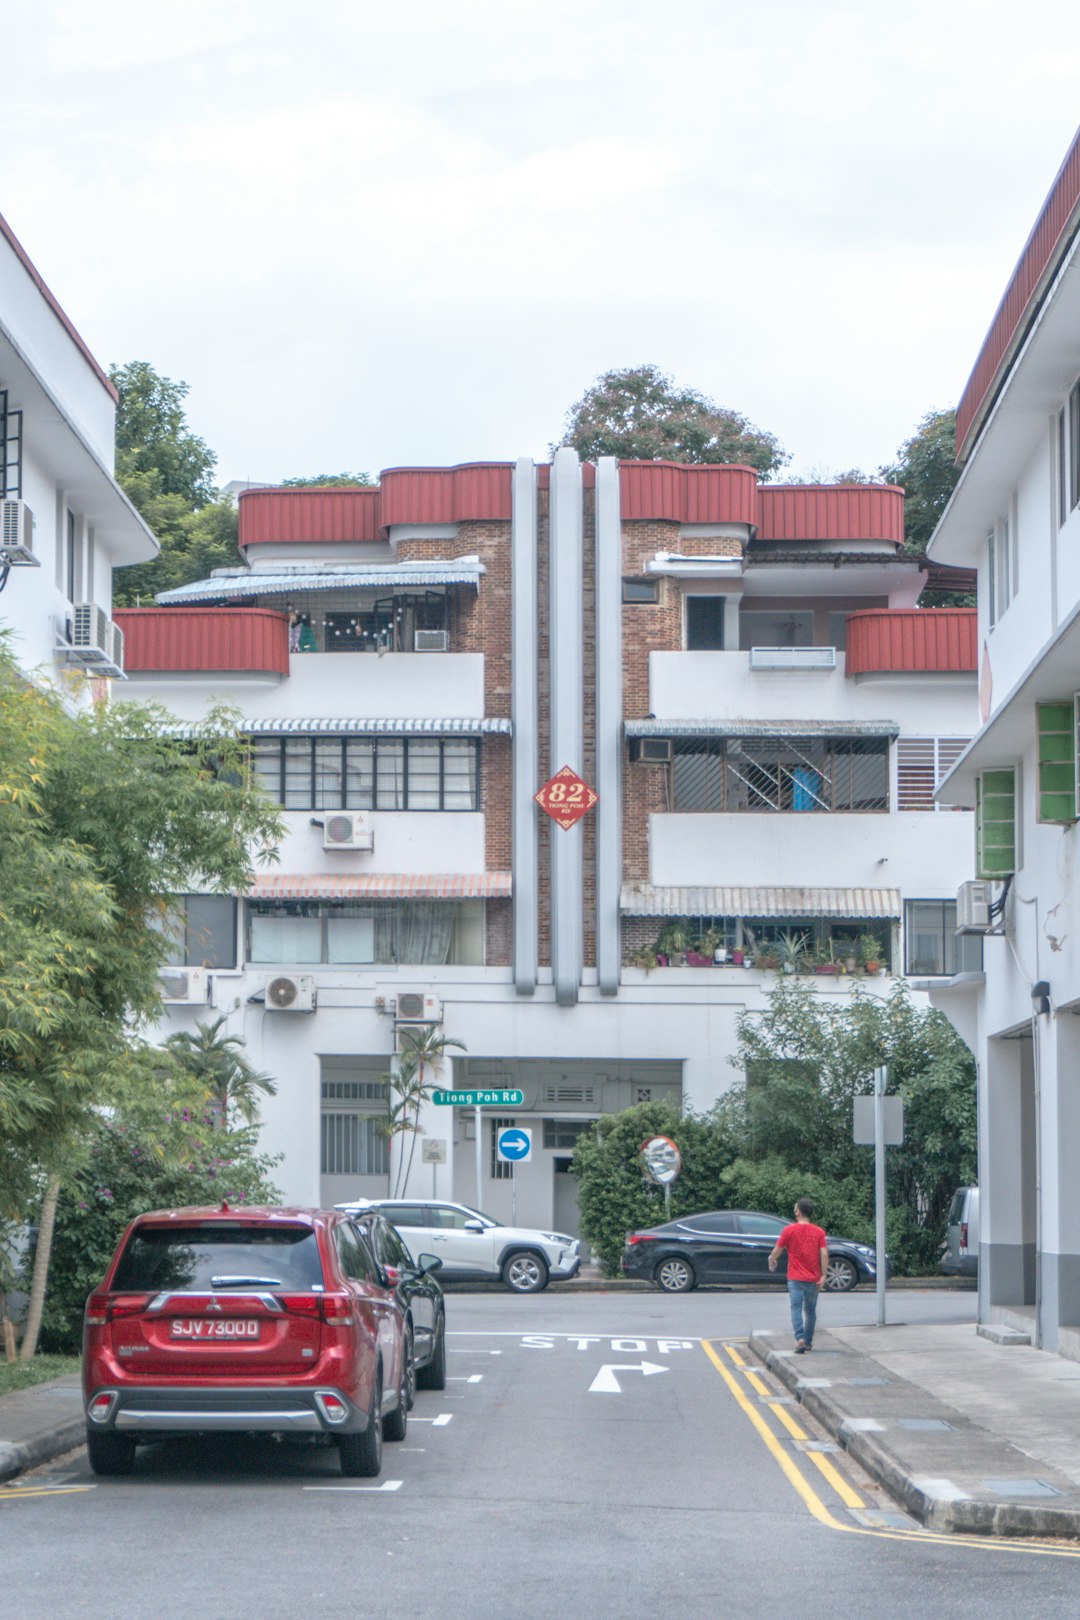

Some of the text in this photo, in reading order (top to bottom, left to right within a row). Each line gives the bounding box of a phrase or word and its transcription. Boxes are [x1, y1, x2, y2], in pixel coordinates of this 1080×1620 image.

[548, 783, 584, 802] 82
[439, 1092, 517, 1104] Tiong Poh Rd
[519, 1336, 693, 1354] STOP
